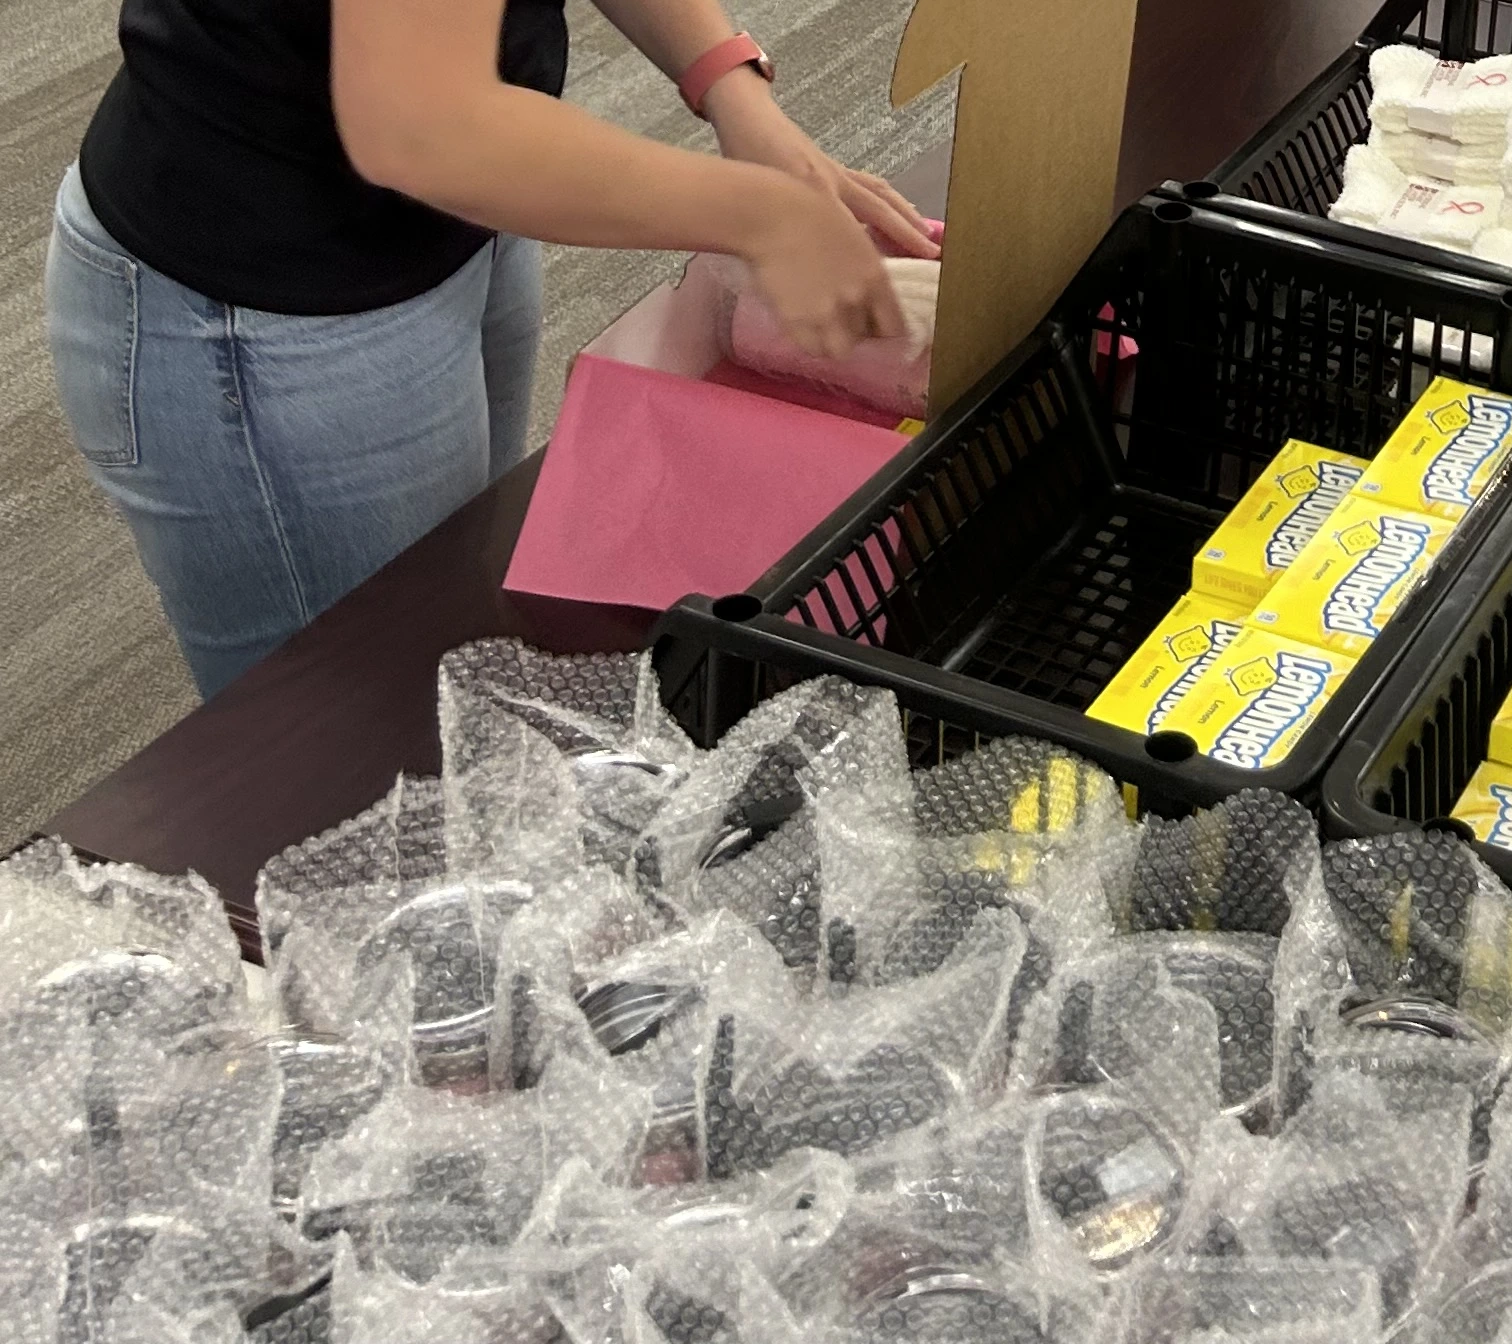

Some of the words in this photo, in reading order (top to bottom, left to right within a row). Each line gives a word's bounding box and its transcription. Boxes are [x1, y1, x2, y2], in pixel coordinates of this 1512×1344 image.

[1256, 500, 1278, 522] Lemon
[1140, 665, 1167, 689] Lemon
[1197, 698, 1225, 724] Lemon
